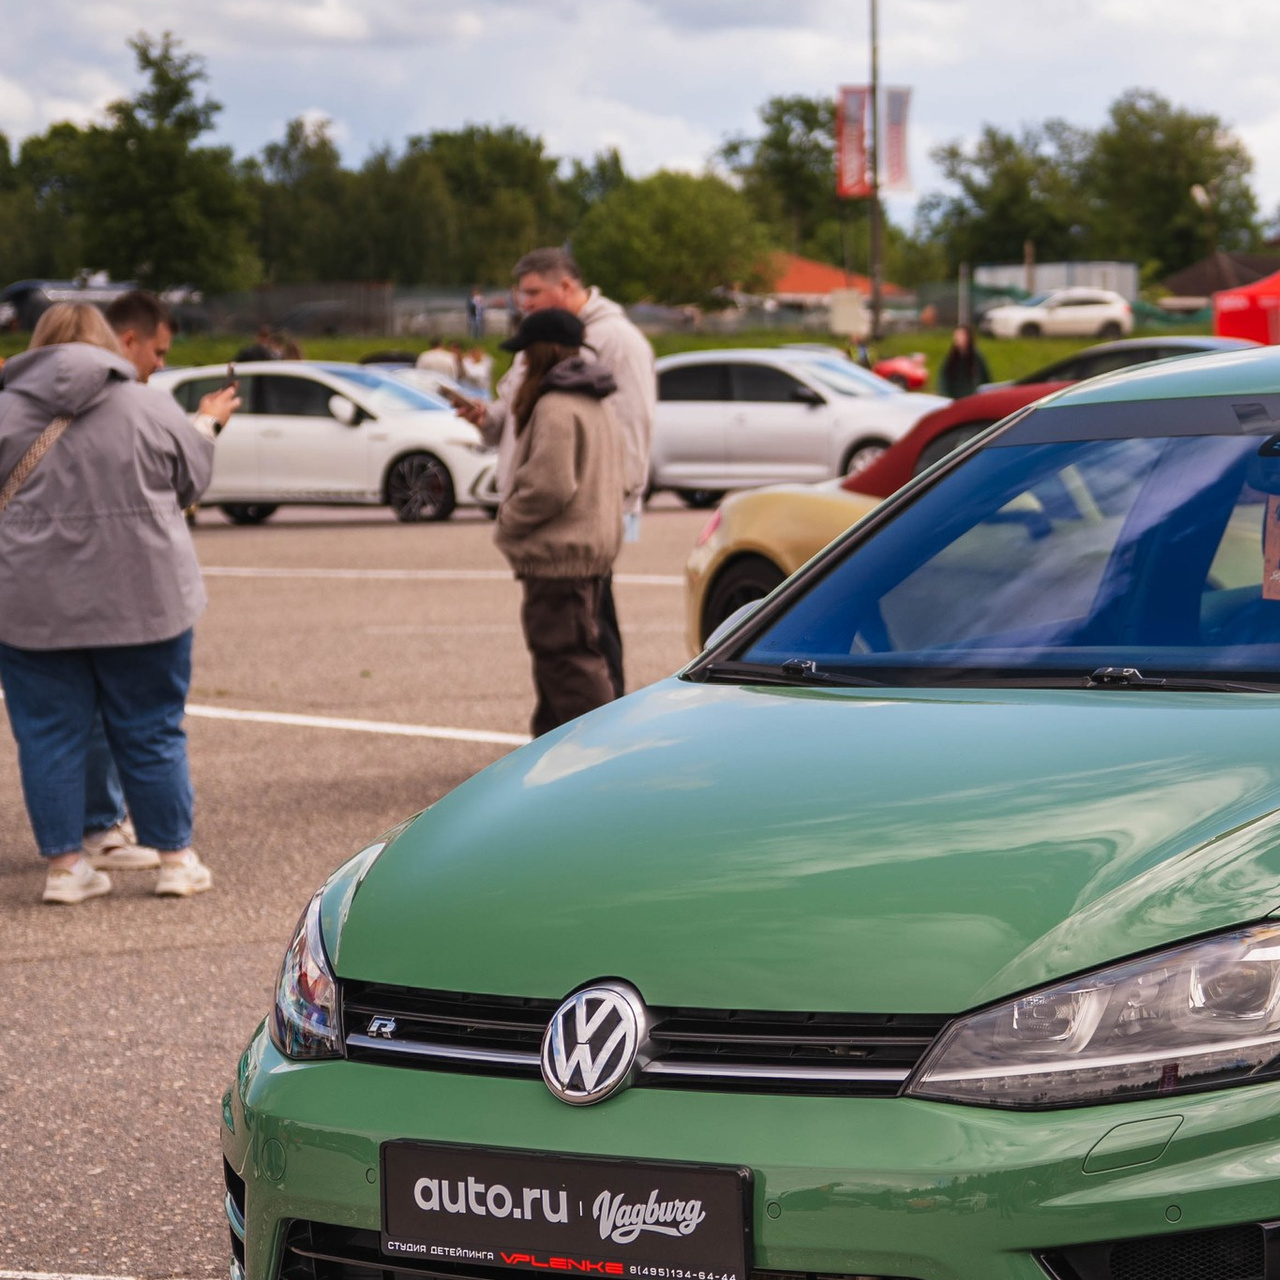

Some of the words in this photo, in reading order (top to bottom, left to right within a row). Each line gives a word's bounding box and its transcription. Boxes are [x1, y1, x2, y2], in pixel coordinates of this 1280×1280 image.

[367, 1014, 396, 1039] R
[413, 1176, 569, 1224] auto.ru
[592, 1188, 706, 1245] Vagburg
[387, 1241, 427, 1254] СТУДИЯ
[500, 1251, 624, 1275] VPLENKE
